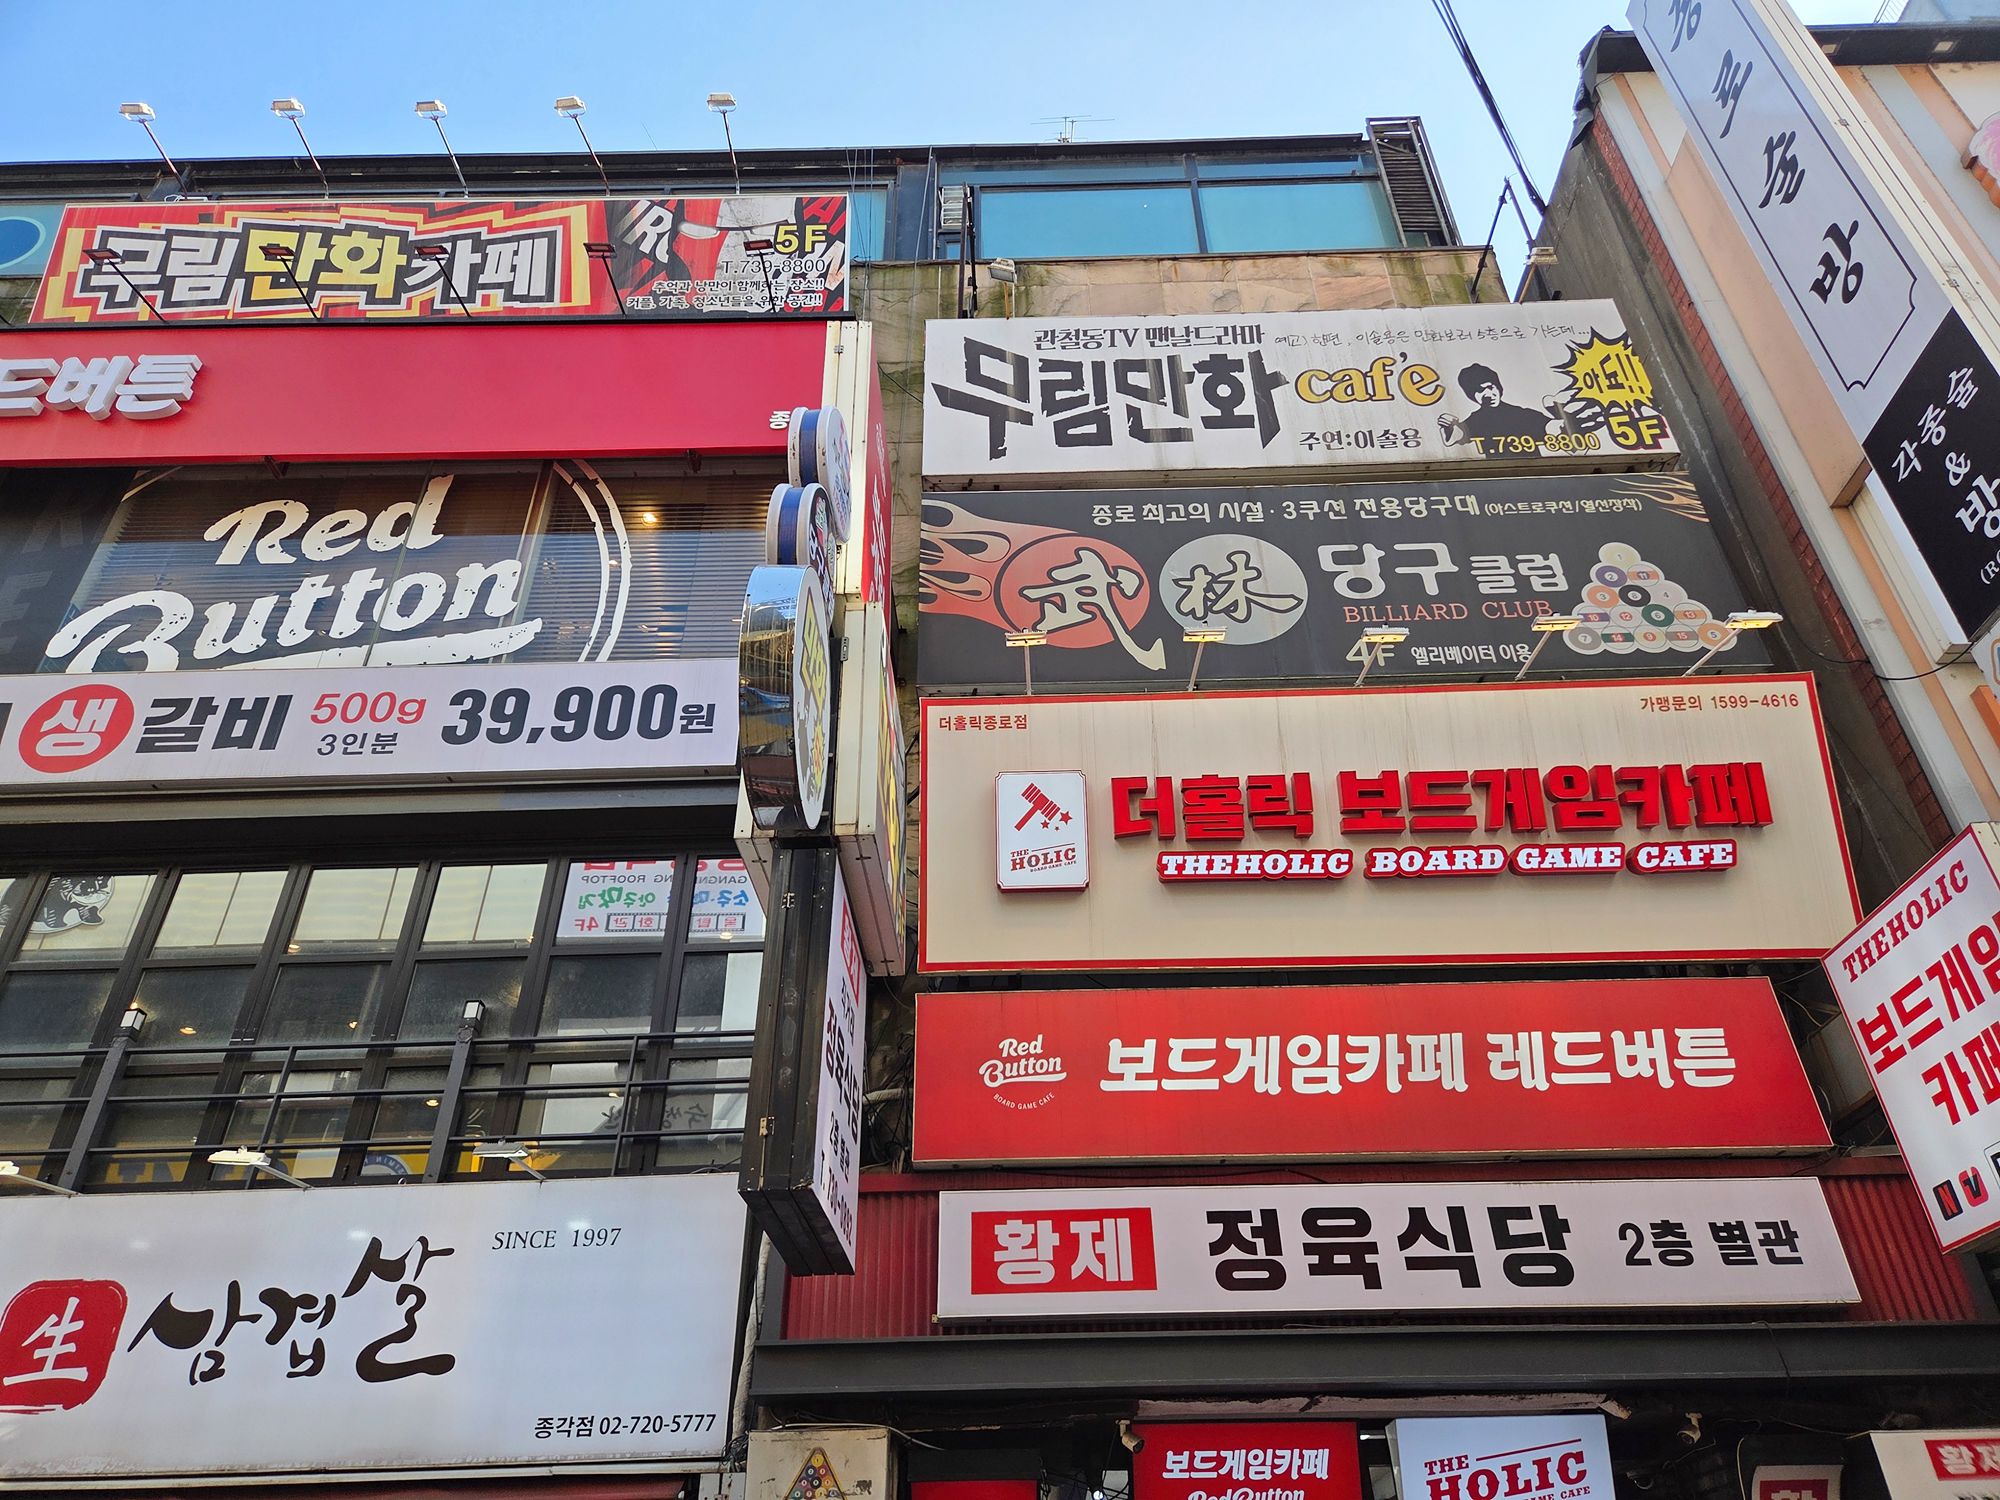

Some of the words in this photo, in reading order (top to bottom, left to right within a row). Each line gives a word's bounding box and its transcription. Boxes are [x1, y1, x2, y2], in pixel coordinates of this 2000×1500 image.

[775, 225, 828, 254] 5F
[721, 259, 827, 275] T.739-8800
[653, 280, 691, 293] 추억과
[694, 280, 734, 293] 낭만이
[1033, 327, 1141, 350] 관철동TV
[1145, 324, 1266, 348] 맨날드라마
[931, 337, 1290, 461] 무림만화
[1608, 415, 1662, 446] 5F
[1891, 367, 1979, 482] 각종술
[1470, 432, 1601, 455] T.739-8800
[1945, 451, 1971, 487] &
[203, 474, 455, 566] Red
[1091, 504, 1137, 526] 종로
[1142, 502, 1211, 524] 최고의
[1218, 501, 1265, 523] 시설
[1282, 499, 1348, 521] 3쿠션
[1353, 494, 1481, 519] 전용당구대
[1317, 541, 1460, 600] 당구
[1469, 552, 1569, 595] 클럽
[45, 559, 523, 673] Button
[1343, 603, 1469, 623] BILLIARD
[1481, 599, 1554, 619] CLUB
[310, 690, 427, 725] 500g
[1639, 695, 1703, 713] 가맹문의
[1710, 693, 1800, 709] 1599-4616
[135, 694, 294, 754] 갈비
[939, 714, 1029, 731] 더홀릭종로점
[316, 731, 399, 756] 3인분
[1111, 772, 1316, 842] 더홀릭
[1337, 761, 1775, 836] 보드게임카페
[1010, 848, 1030, 858] THE
[1010, 847, 1077, 872] HOLIC
[1370, 847, 1505, 873] BOARD
[1515, 845, 1622, 870] GAME
[1636, 842, 1734, 868] CAFE
[998, 1033, 1044, 1058] Red
[978, 1056, 1065, 1088] Button
[1099, 1032, 1470, 1096] 보드게임카페
[1486, 1027, 1737, 1092] 레드버튼
[993, 1092, 1016, 1109] BOARD
[1017, 1101, 1038, 1110] GAME
[1038, 1091, 1056, 1106] CAFE
[491, 1229, 557, 1251] SINCE
[572, 1227, 622, 1249] 1997
[993, 1217, 1135, 1285] 황제
[1205, 1204, 1576, 1292] 정육식당
[1617, 1219, 1696, 1268] 2층
[1707, 1219, 1805, 1267] 별관
[127, 1235, 457, 1386] 삼겹살
[2, 1296, 90, 1386] 生
[534, 1415, 596, 1440] 종각점
[599, 1413, 717, 1436] 02-720-5777
[1161, 1448, 1331, 1481] 보드게임카페
[1424, 1454, 1470, 1476] THE
[1425, 1450, 1588, 1500] HOLIC
[1560, 1485, 1591, 1499] CAFE
